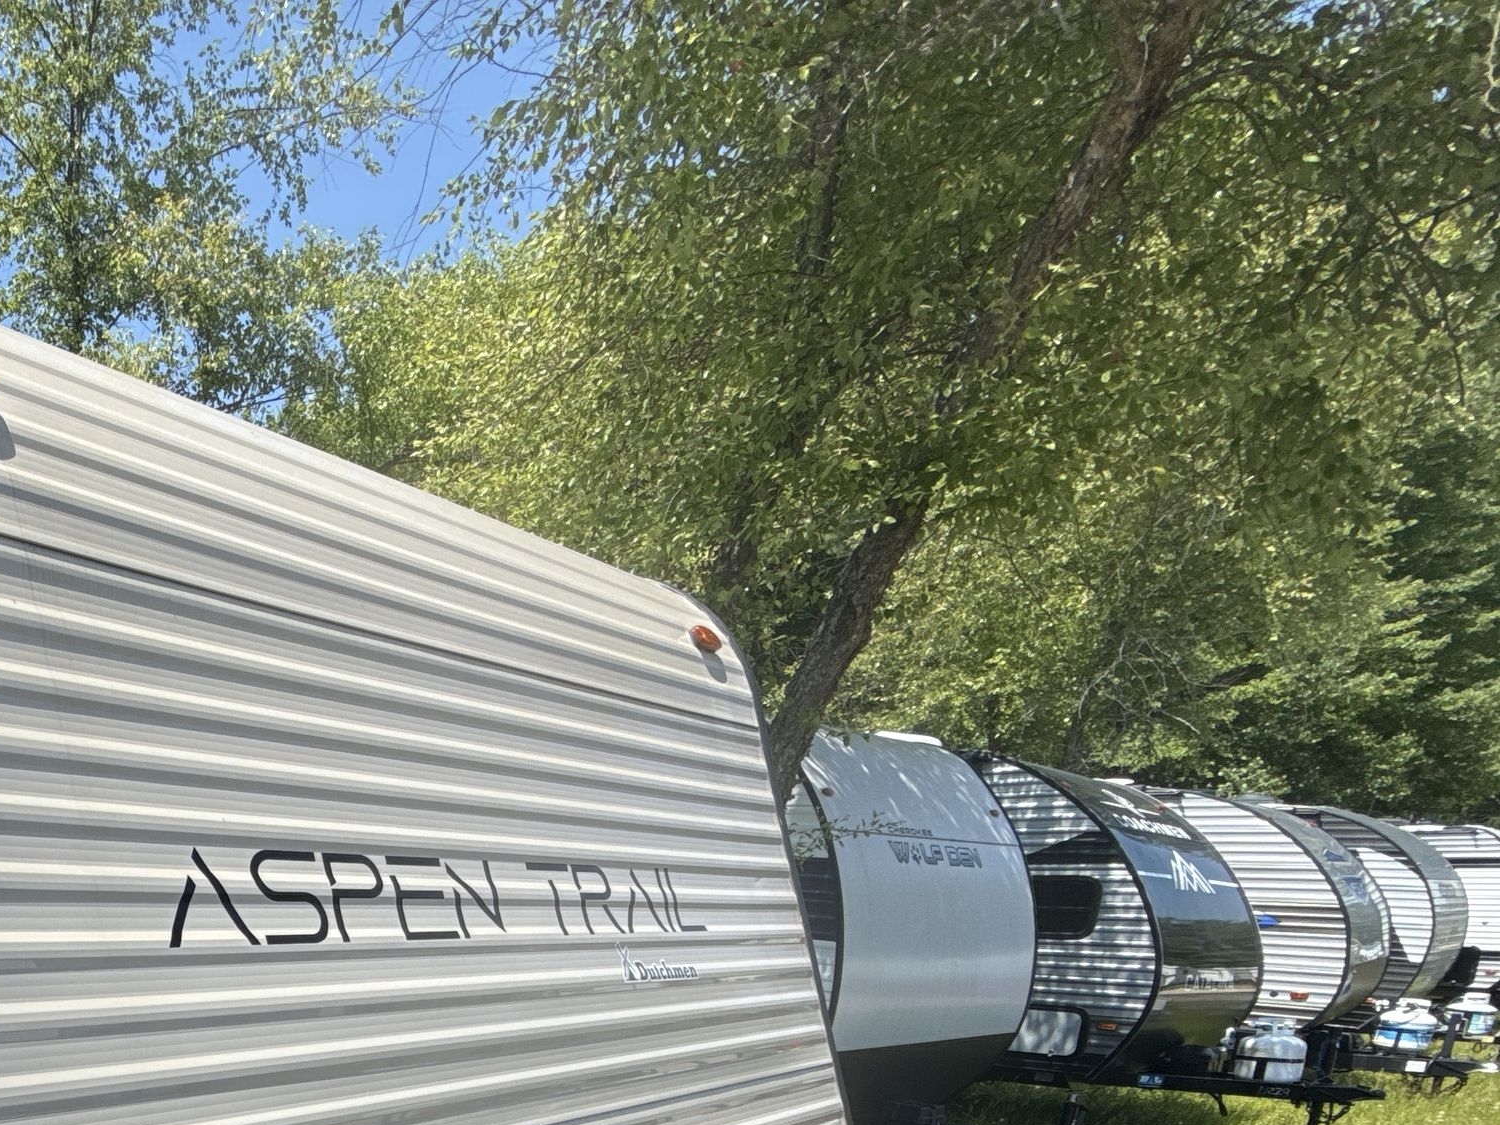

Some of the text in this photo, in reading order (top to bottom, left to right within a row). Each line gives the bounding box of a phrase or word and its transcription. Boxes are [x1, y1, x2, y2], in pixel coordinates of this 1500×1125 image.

[887, 826, 934, 837] CHEROKEE
[1112, 813, 1192, 840] COACHMEN
[944, 846, 983, 869] DEN
[169, 847, 707, 948] ASPEN TRAIL
[633, 960, 699, 981] Dutchmen
